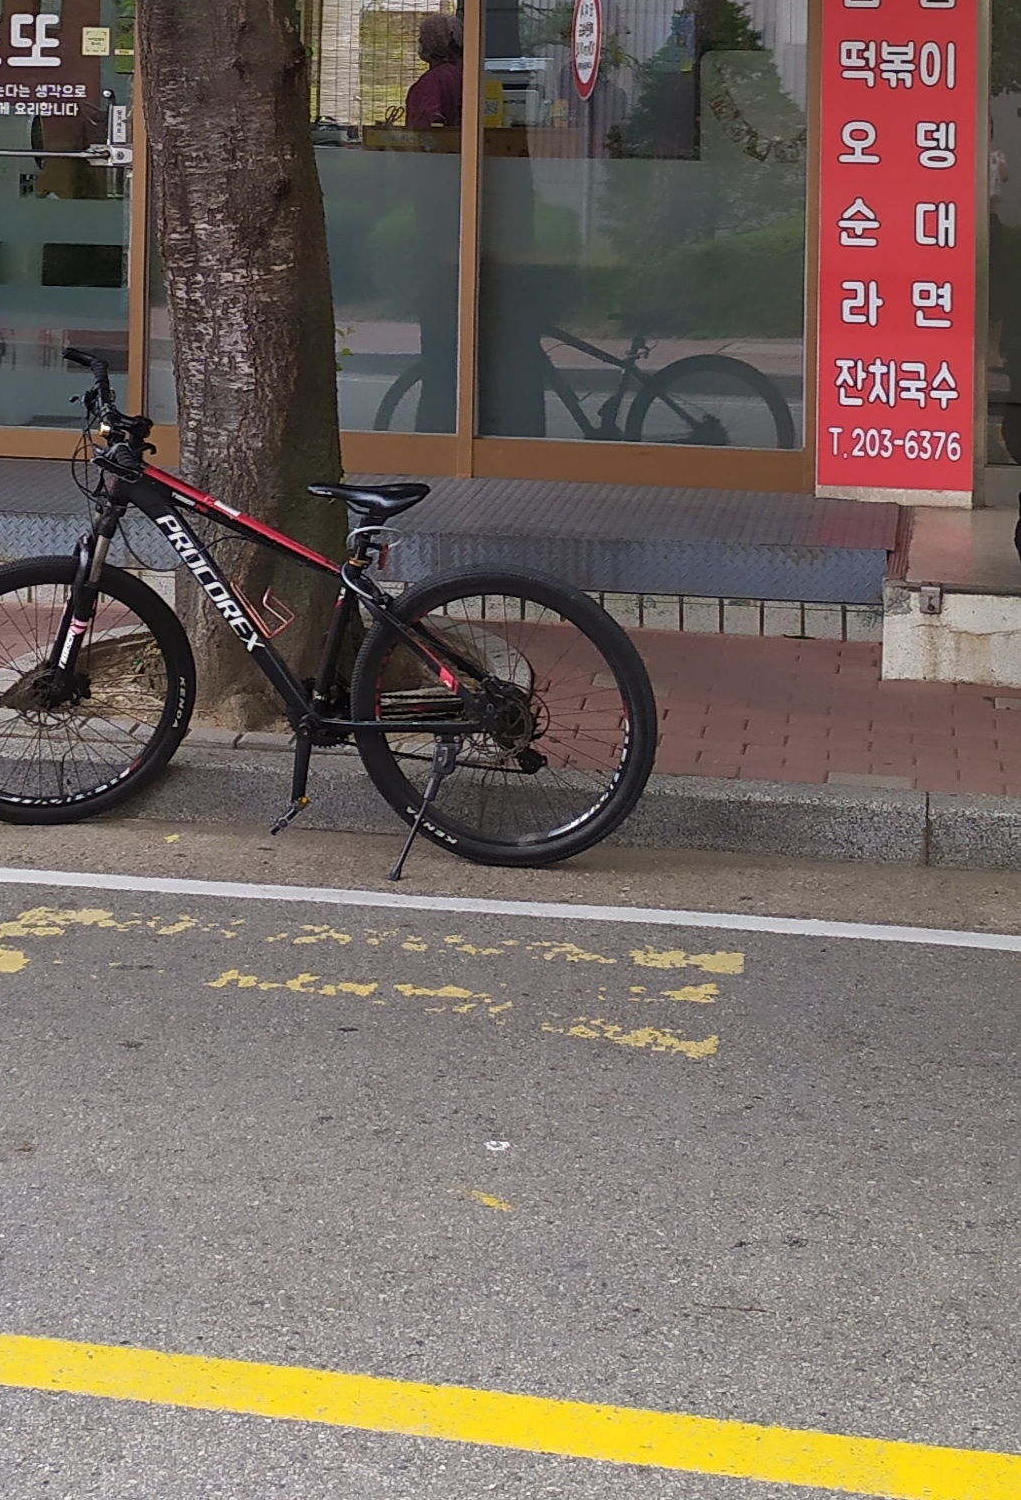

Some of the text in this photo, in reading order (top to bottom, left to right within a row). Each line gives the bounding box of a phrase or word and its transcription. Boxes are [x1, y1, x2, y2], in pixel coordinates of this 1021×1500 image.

[839, 40, 957, 90] 떡볶이
[14, 102, 79, 116] 요리합니다
[35, 84, 87, 98] 생각으로
[834, 357, 959, 410] 잔치국수
[155, 514, 265, 652] PROCOREX
